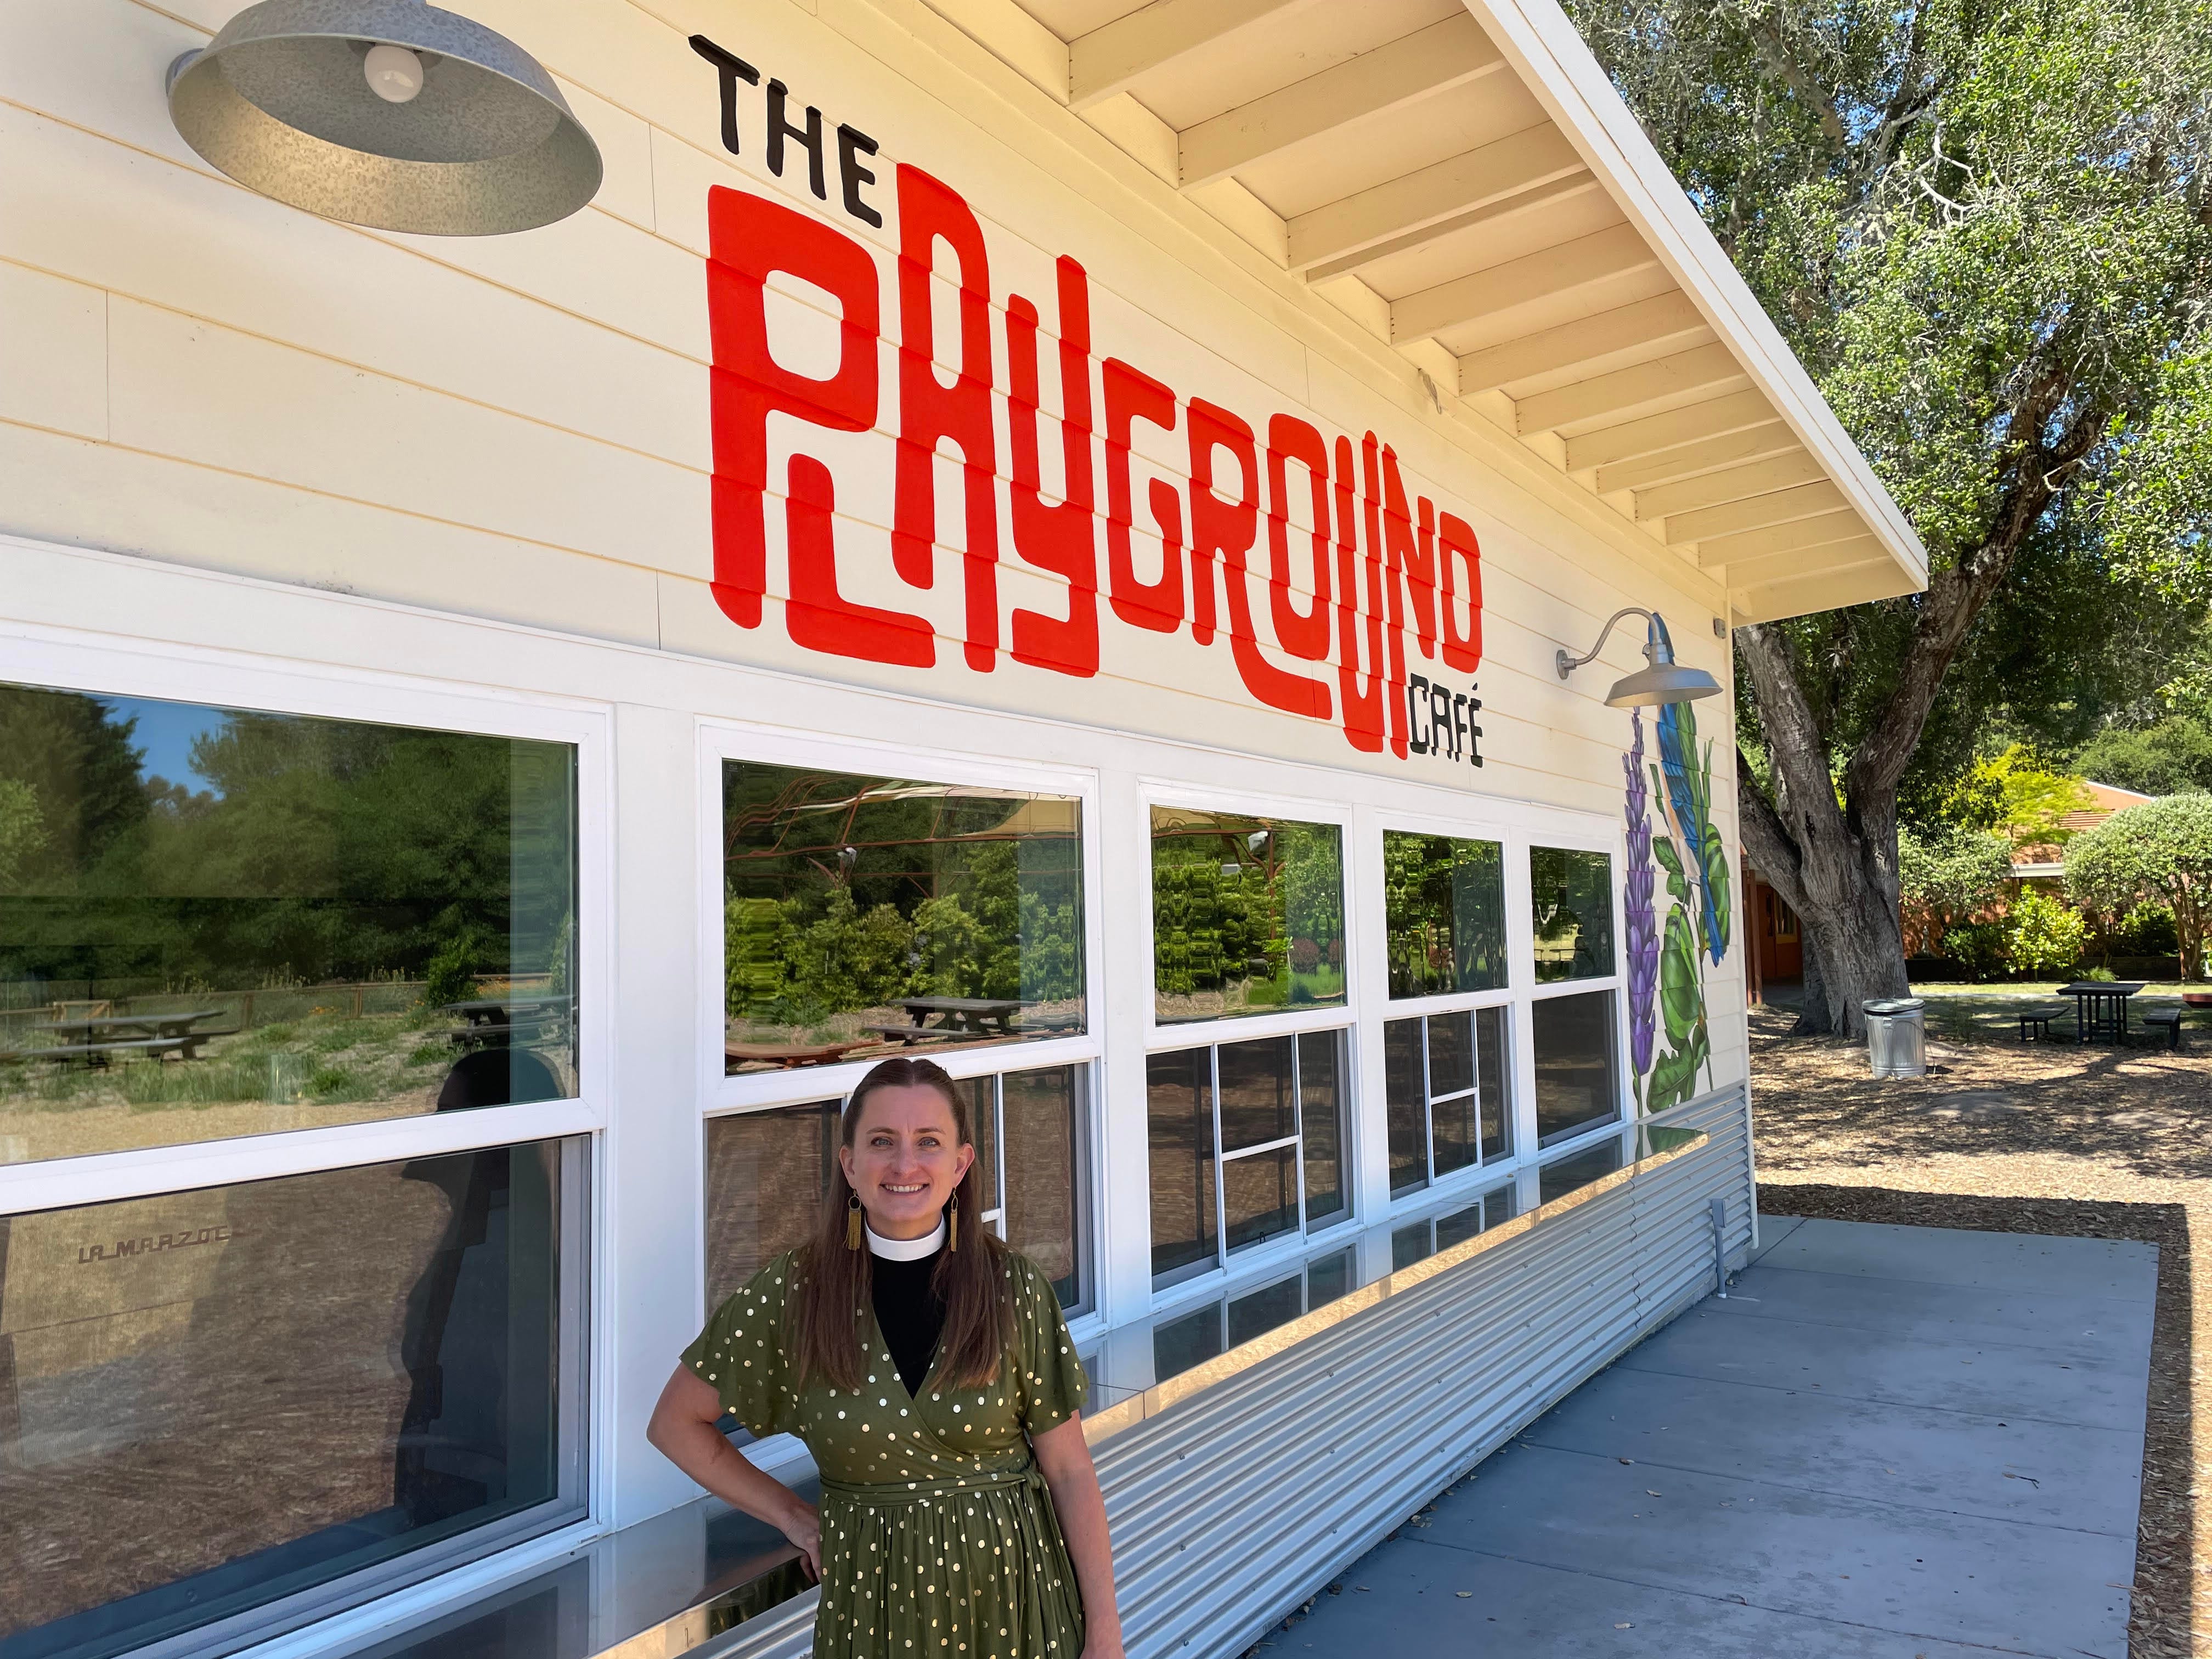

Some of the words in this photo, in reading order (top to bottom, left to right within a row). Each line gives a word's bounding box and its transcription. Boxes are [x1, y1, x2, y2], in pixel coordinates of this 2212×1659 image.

[688, 34, 882, 229] THE
[706, 162, 1483, 760] PLAYGROUND
[1409, 672, 1483, 768] CAFÉ
